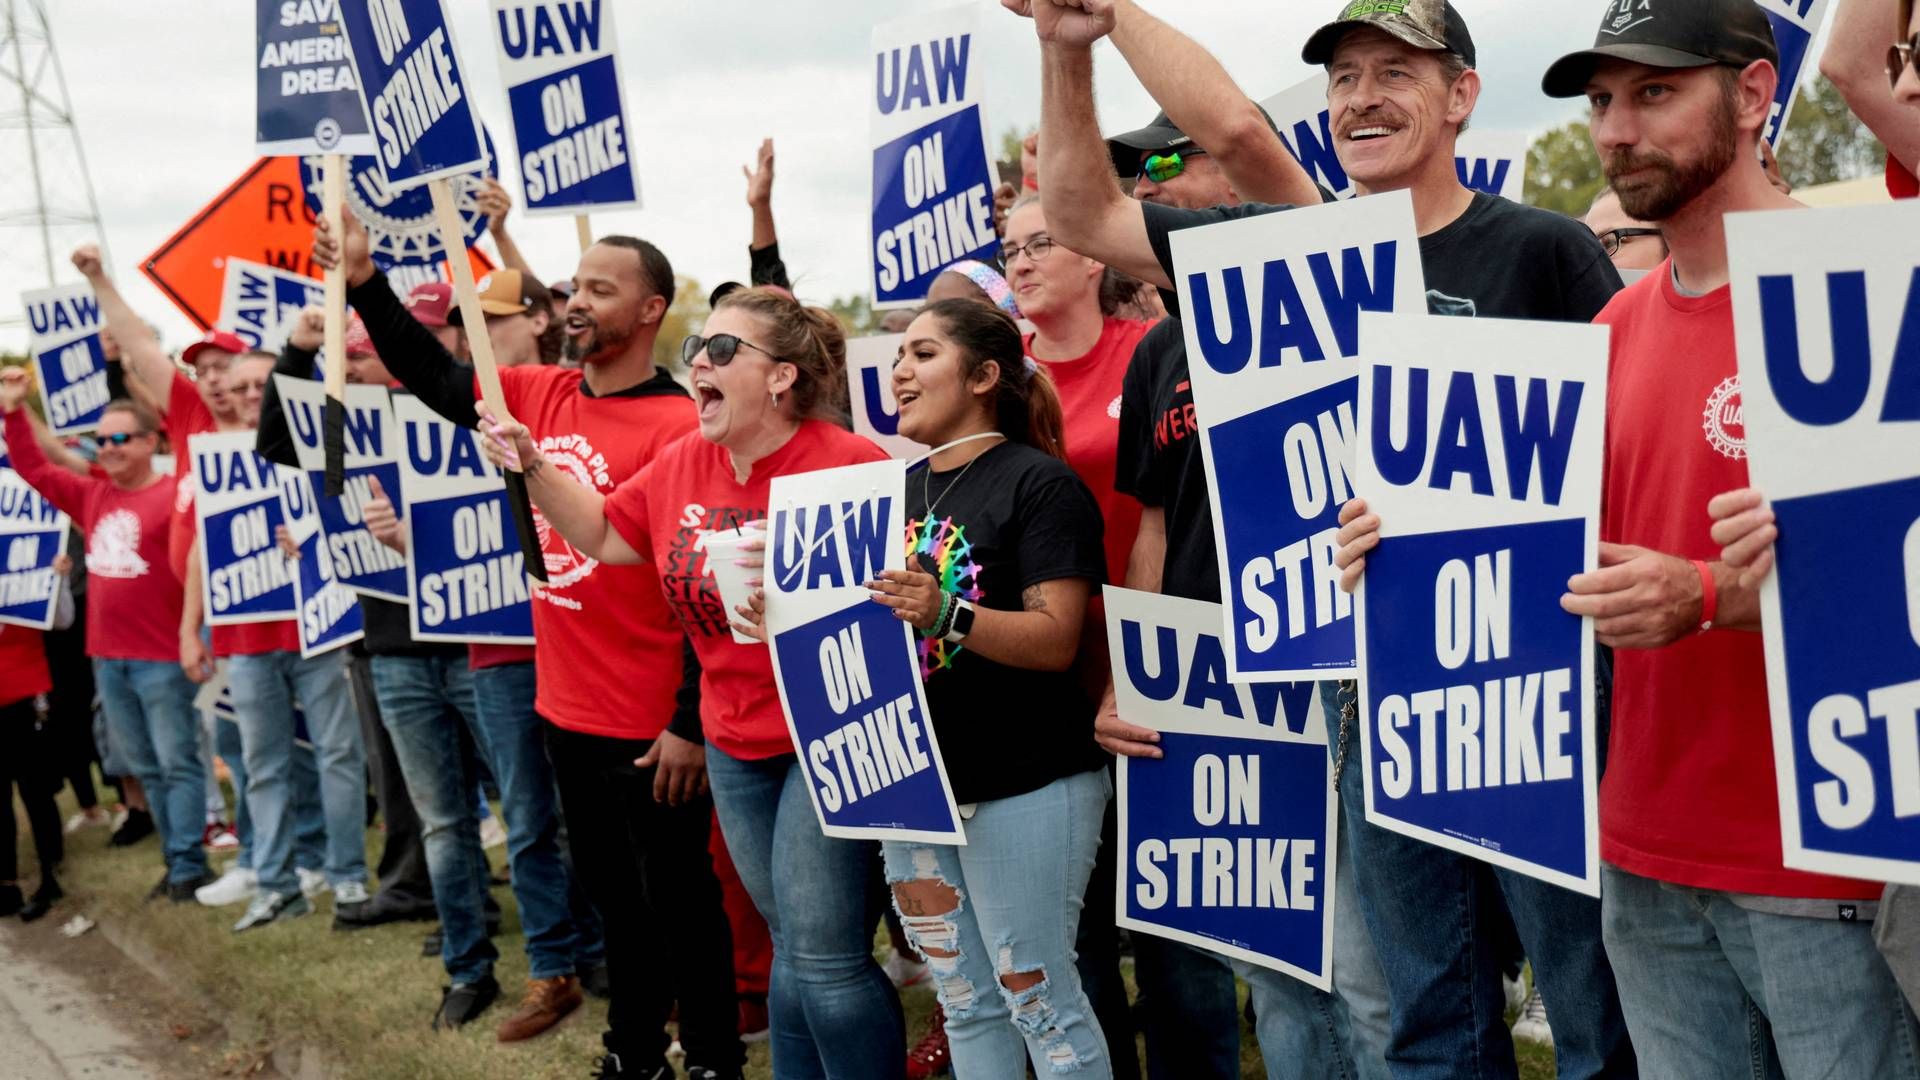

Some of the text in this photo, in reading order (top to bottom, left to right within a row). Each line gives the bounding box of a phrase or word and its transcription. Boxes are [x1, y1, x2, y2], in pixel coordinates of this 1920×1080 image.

[367, 0, 412, 66] ON
[498, 0, 602, 59] UAW
[281, 66, 363, 97] DREA
[373, 26, 461, 169] STRIKE
[541, 73, 586, 137] ON
[876, 34, 971, 116] UAW
[522, 114, 626, 202] STRIKE
[903, 131, 947, 209] ON
[876, 182, 996, 293] STRIKE
[28, 294, 100, 336] UAW
[235, 270, 268, 349] UAW
[1188, 240, 1397, 374] UAW
[59, 340, 95, 384] ON
[405, 420, 505, 478] UA
[1371, 364, 1585, 507] UAW
[1722, 404, 1744, 426] UA
[200, 450, 279, 493] UAW
[1283, 401, 1358, 520] ON
[7, 534, 41, 572] ON
[230, 505, 270, 558] ON
[328, 528, 406, 580] STRI
[452, 499, 504, 561] ON
[773, 496, 893, 593] UAW
[210, 546, 295, 612] STRIK
[420, 552, 531, 627] STRIK
[662, 574, 720, 602] STR
[1240, 527, 1353, 654] STR
[1435, 549, 1512, 670] ON
[819, 621, 873, 715] ON
[1119, 619, 1316, 735] UAW
[808, 692, 931, 814] STRIKE
[1378, 668, 1574, 800] STRIKE
[1193, 754, 1261, 826] ON
[1135, 837, 1316, 911] STRIKE
